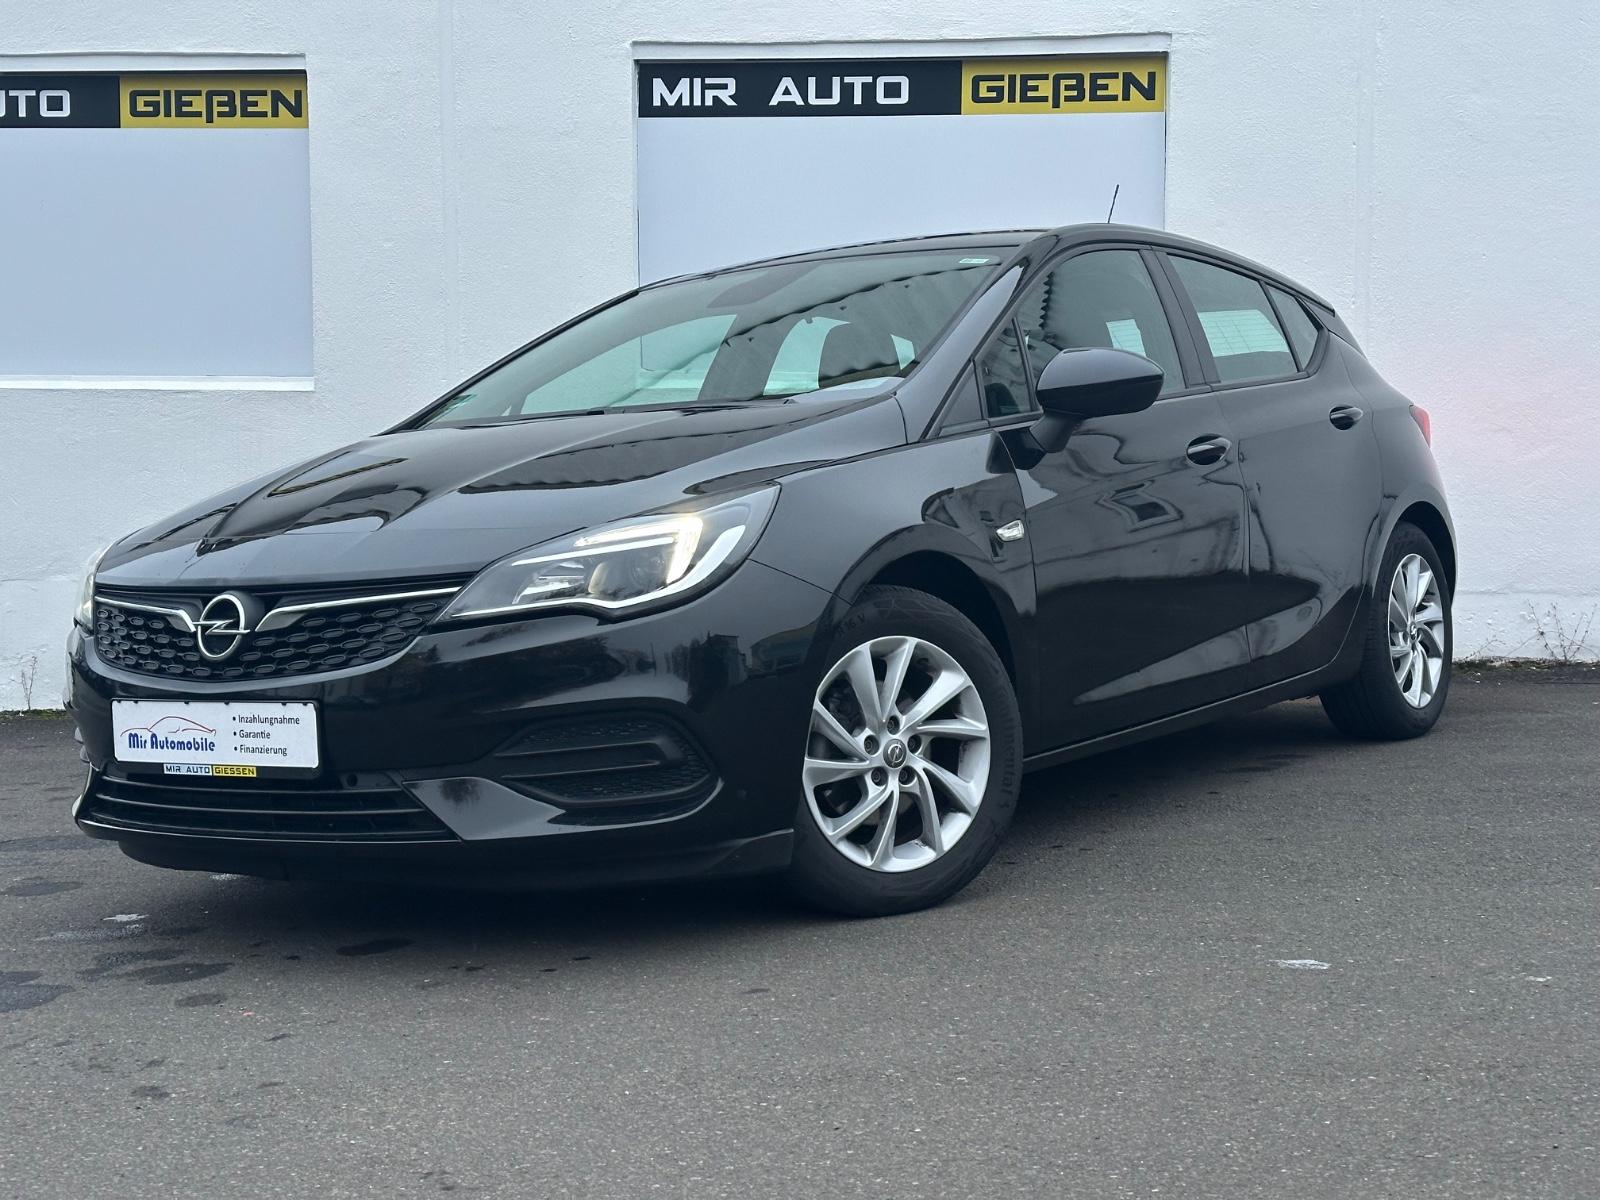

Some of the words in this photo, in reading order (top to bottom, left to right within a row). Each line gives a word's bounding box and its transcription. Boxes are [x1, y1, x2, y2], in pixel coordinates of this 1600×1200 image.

[652, 76, 737, 107] MIR
[768, 74, 910, 106] AUTO
[0, 89, 71, 118] TO
[238, 714, 300, 726] Inzahlungnahme
[238, 729, 271, 740] Garantie
[128, 732, 148, 749] Mir
[150, 732, 216, 752] Automobile
[239, 744, 288, 757] Finanzierung
[165, 765, 182, 774] MIR
[186, 766, 211, 775] AUTO
[214, 766, 256, 776] GIESSEN
